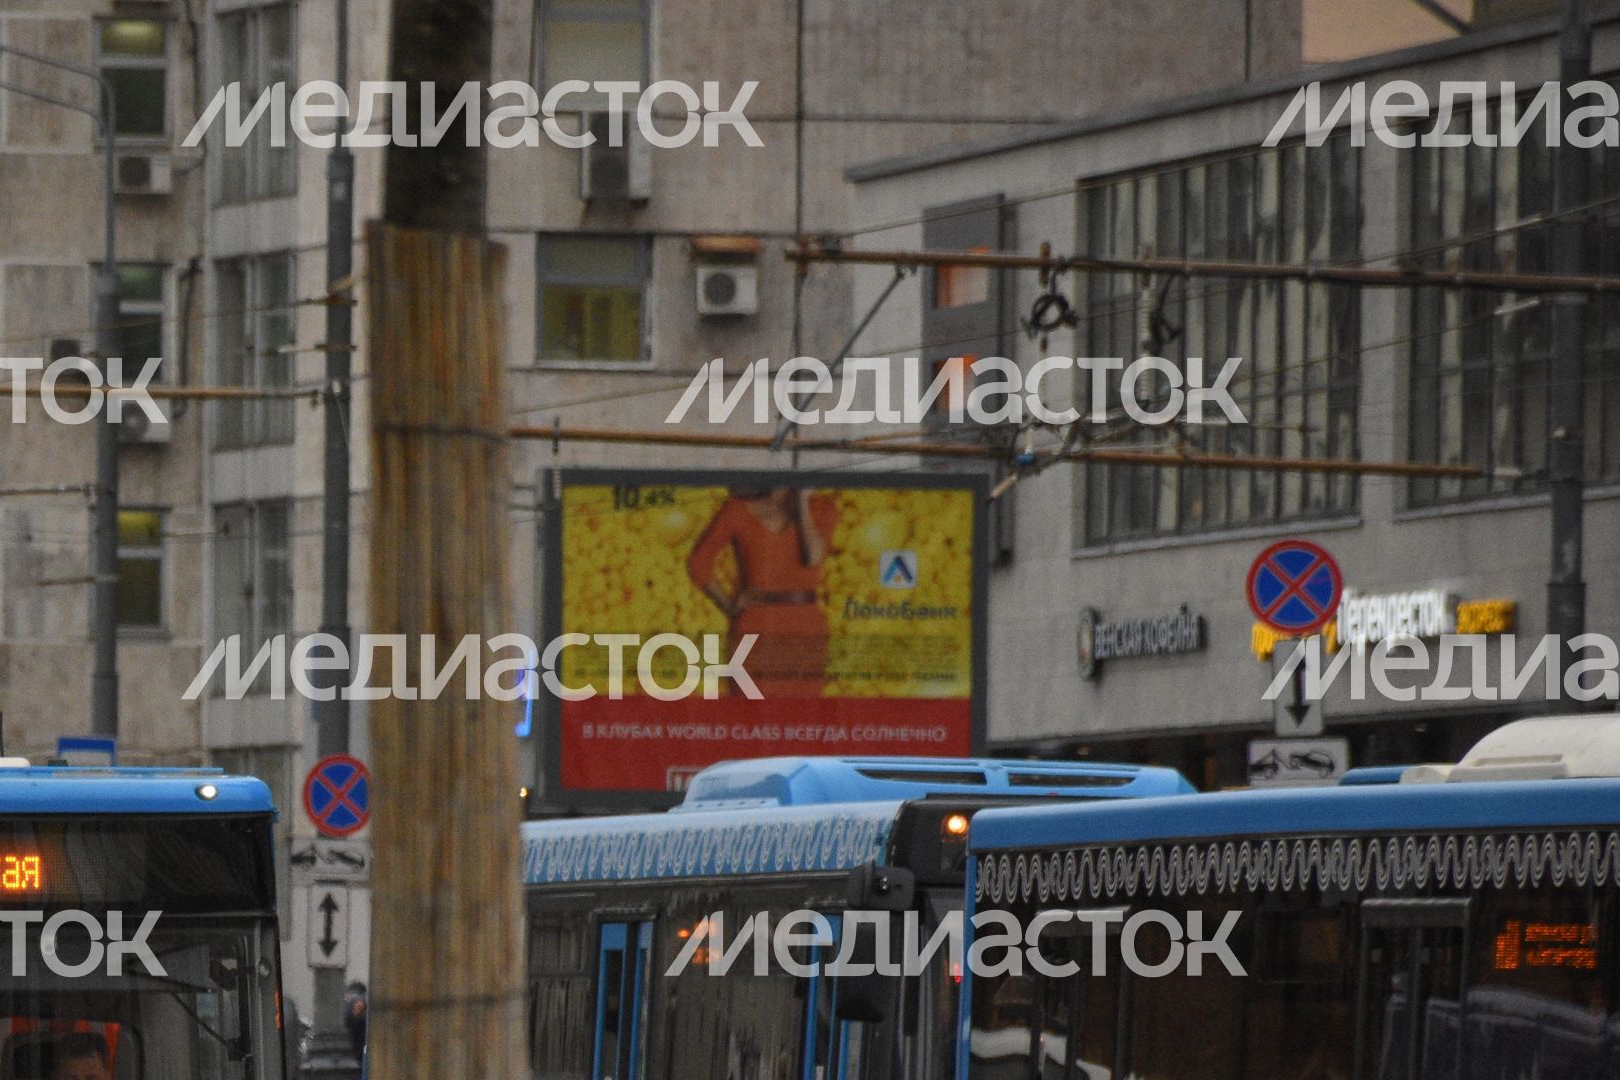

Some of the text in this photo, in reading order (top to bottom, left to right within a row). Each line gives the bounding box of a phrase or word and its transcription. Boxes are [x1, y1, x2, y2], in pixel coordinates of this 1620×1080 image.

[596, 724, 663, 739] КЛУБАХ
[667, 724, 727, 740] WORLD
[731, 725, 780, 740] CLASS
[784, 726, 847, 742] ВСЕГДА
[852, 726, 948, 742] СОЛНЕЧНО
